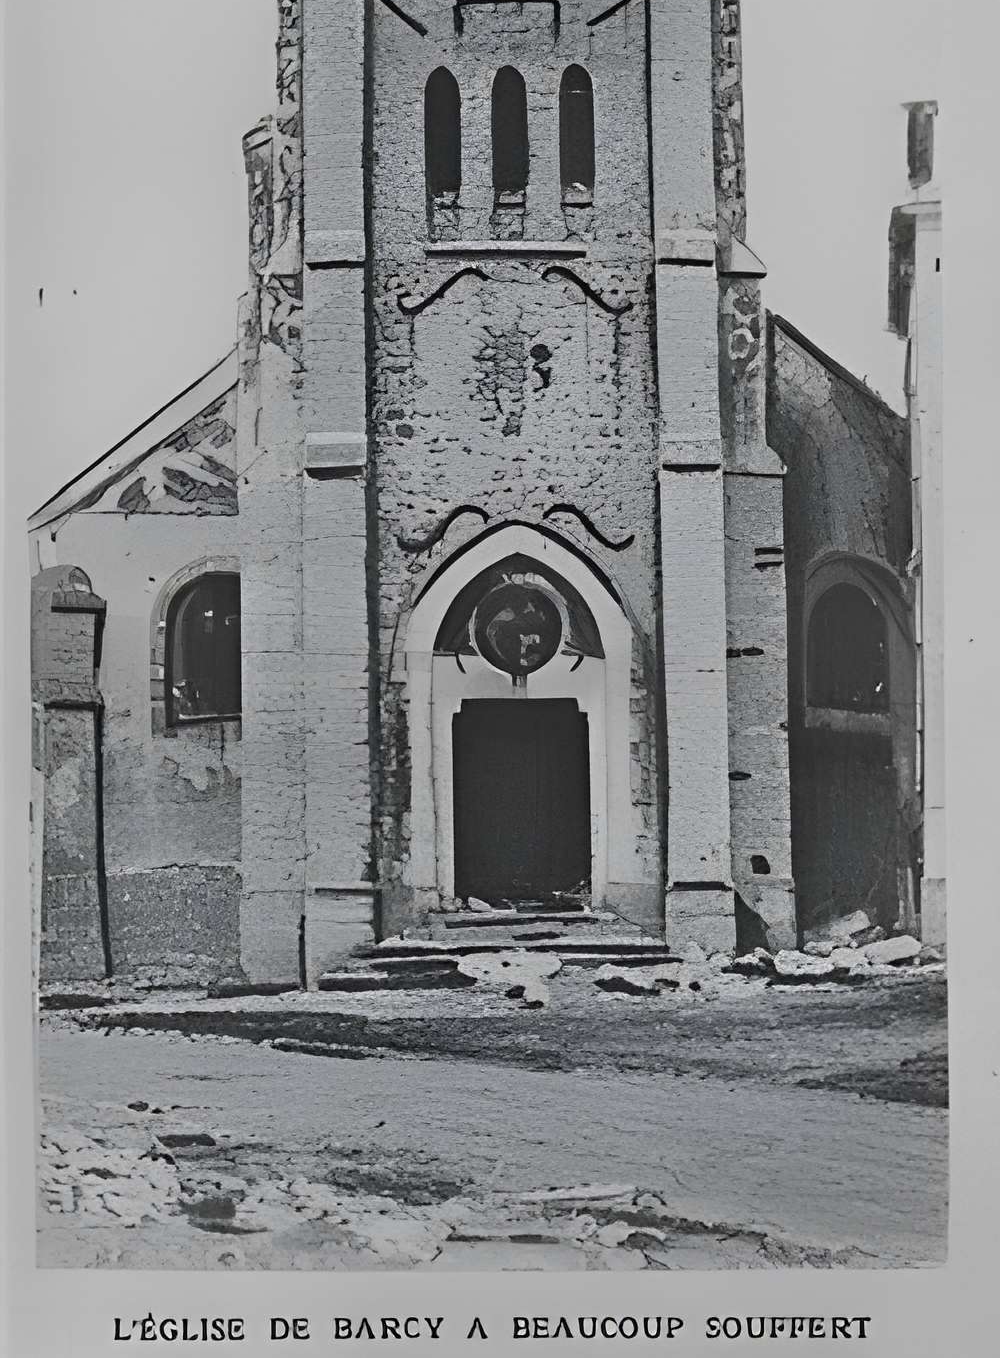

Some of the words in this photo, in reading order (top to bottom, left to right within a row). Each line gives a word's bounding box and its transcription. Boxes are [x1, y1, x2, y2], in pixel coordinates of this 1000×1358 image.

[113, 1311, 246, 1342] L'ÉGLISE
[269, 1317, 311, 1341] DE
[333, 1316, 445, 1340] BARCY
[466, 1316, 489, 1340] A
[512, 1316, 685, 1340] BEAUCOUP
[705, 1316, 872, 1340] SOUFFERT
